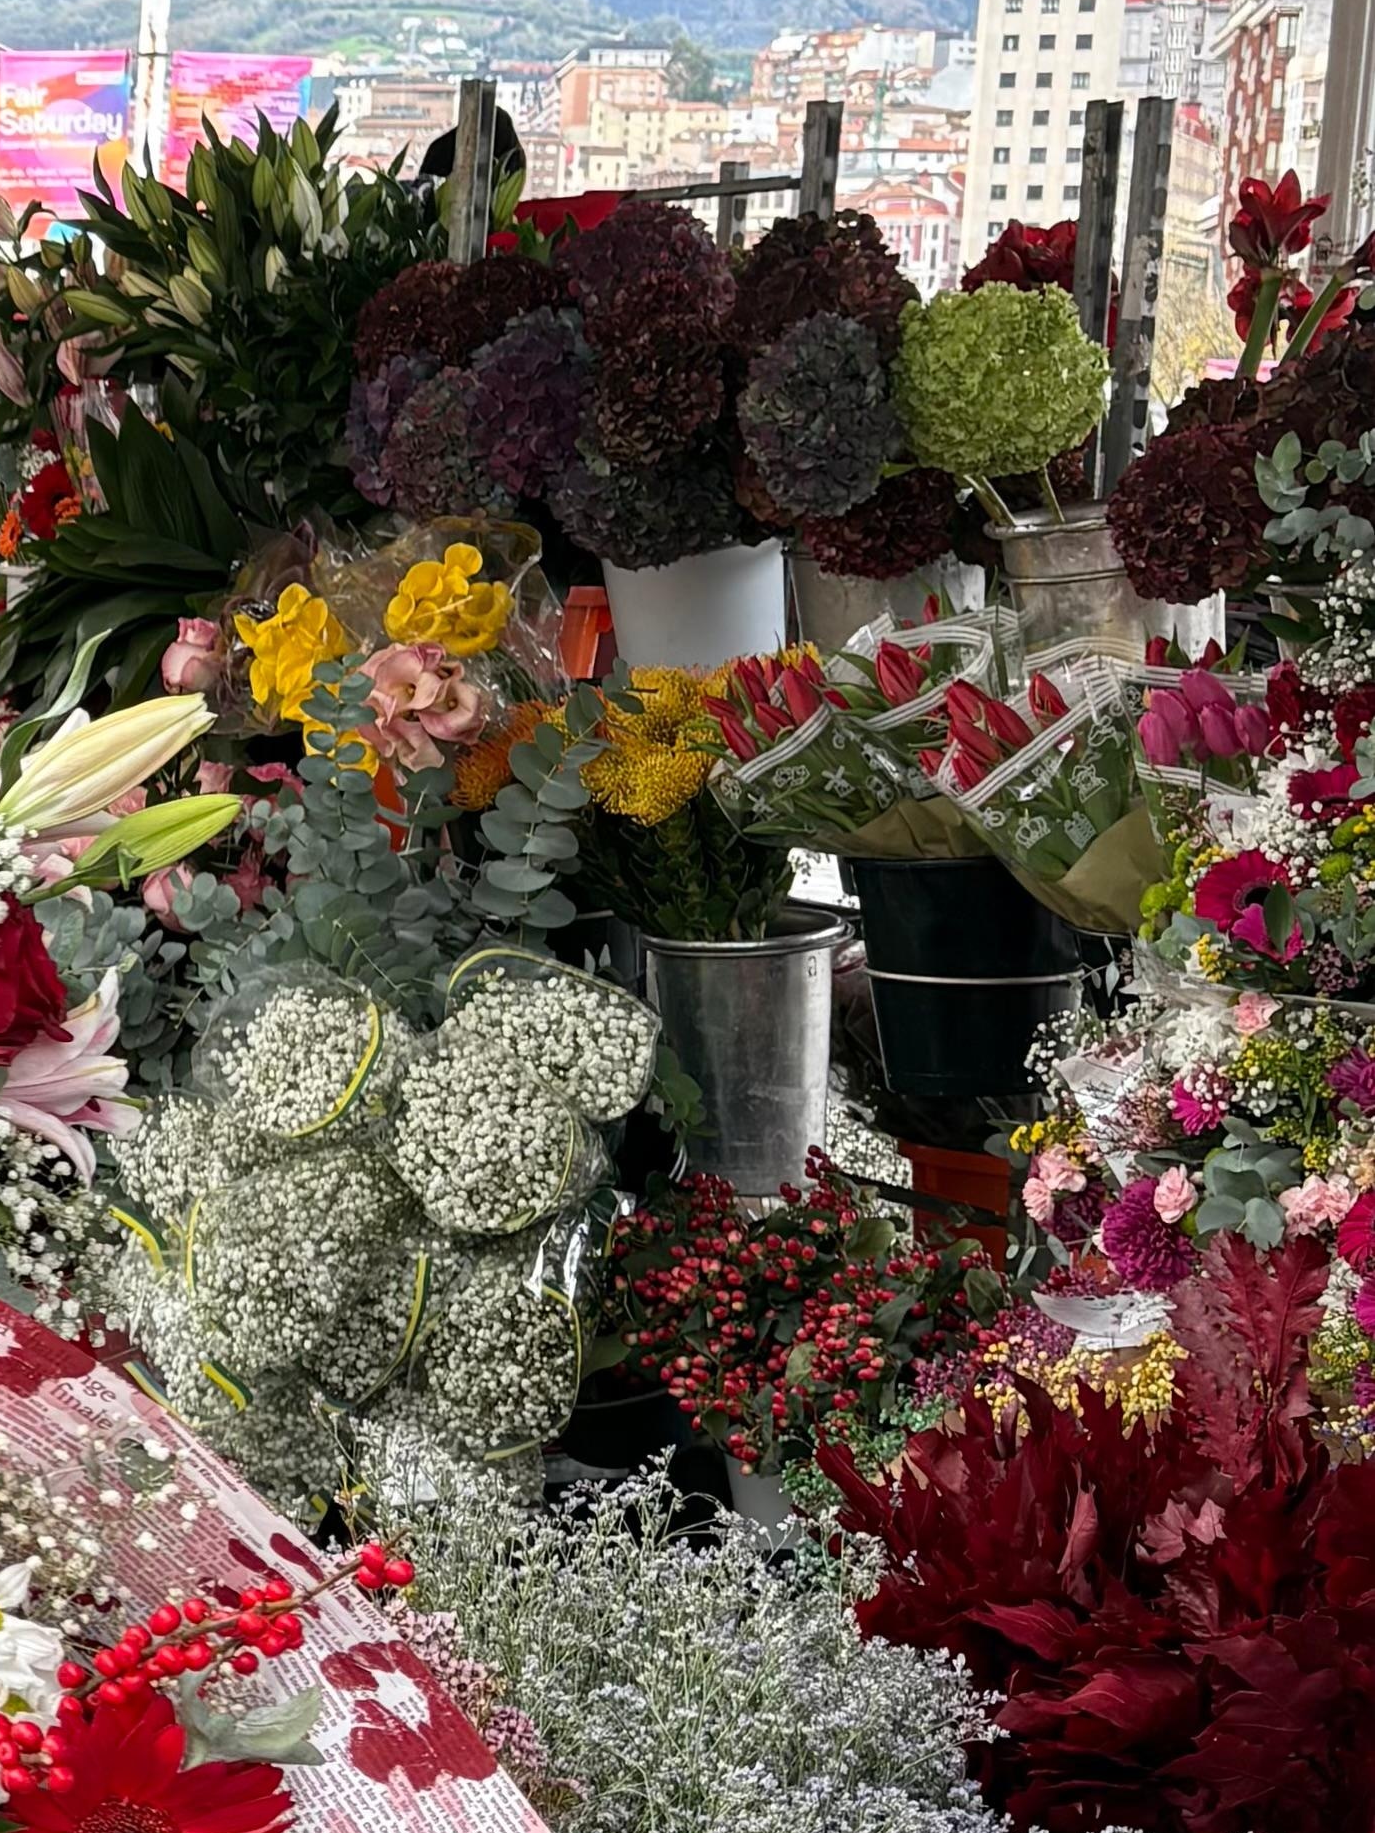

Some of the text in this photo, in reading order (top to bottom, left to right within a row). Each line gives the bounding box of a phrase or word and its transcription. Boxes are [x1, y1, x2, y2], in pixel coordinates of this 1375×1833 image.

[0, 82, 49, 108] Fair
[0, 110, 124, 139] Saturday
[48, 1377, 118, 1432] finale
